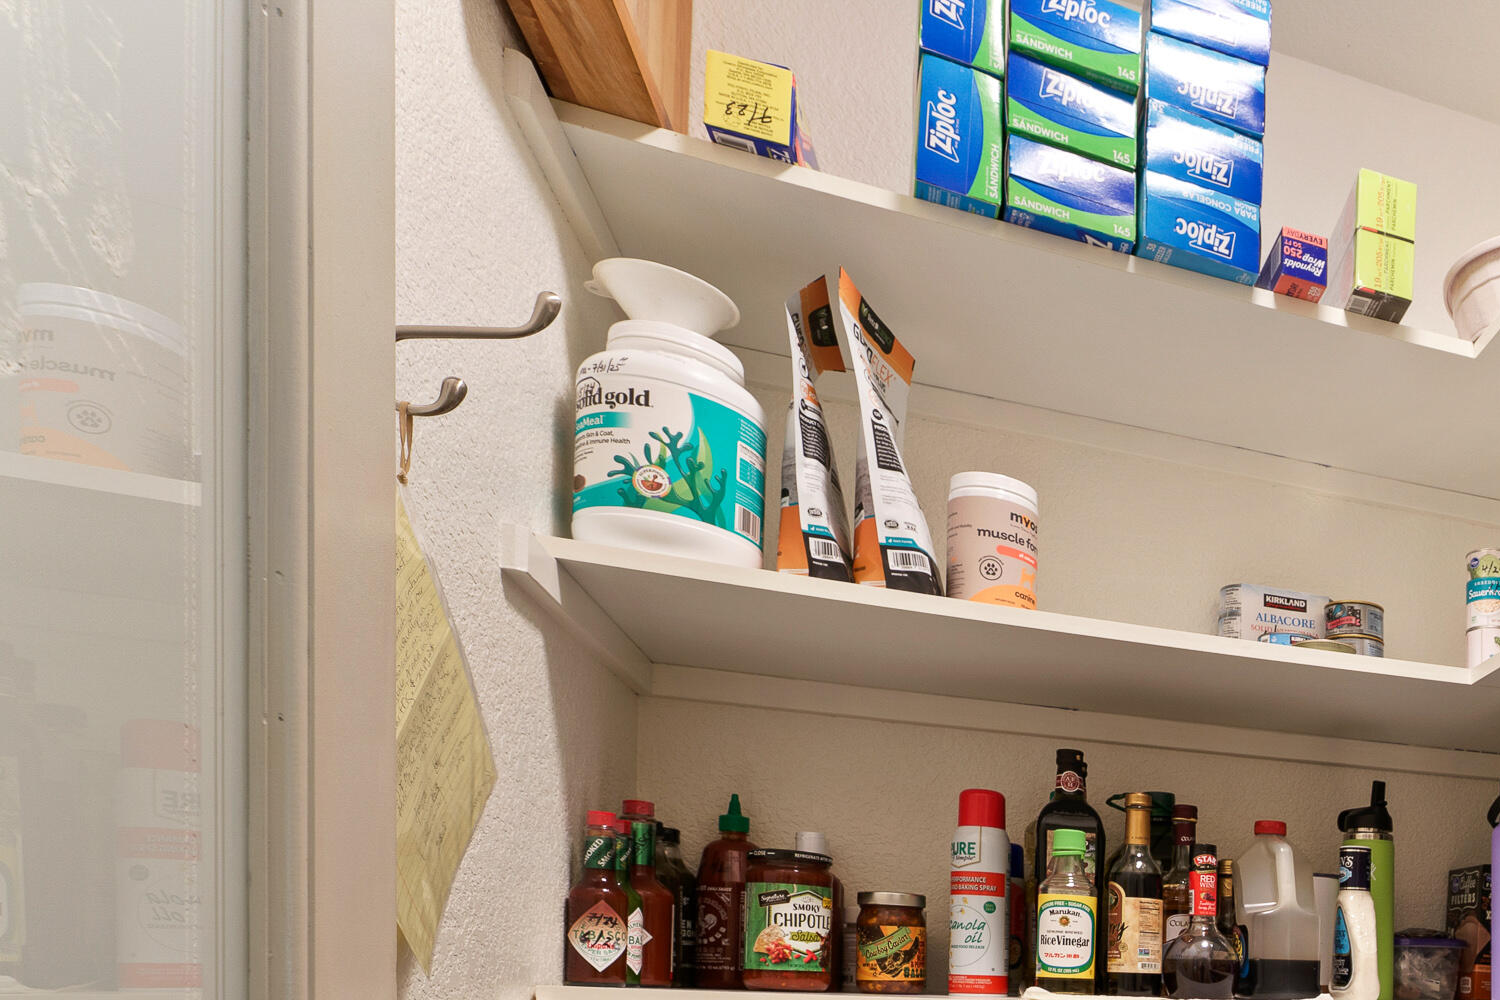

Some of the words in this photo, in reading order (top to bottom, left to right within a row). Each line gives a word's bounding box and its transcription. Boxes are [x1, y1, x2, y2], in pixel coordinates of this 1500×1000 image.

[1117, 66, 1136, 81] 145
[1177, 80, 1236, 119] Ziploc
[933, 90, 957, 155] Ziploc
[1113, 150, 1131, 164] 145
[1172, 152, 1231, 188] Ziploc
[1113, 224, 1131, 238] 145
[1175, 218, 1235, 259] Ziploc
[1287, 230, 1323, 246] EVERYDAY
[1284, 246, 1303, 260] 250
[1303, 253, 1325, 269] Wrap
[1284, 258, 1323, 277] Reynolds
[604, 387, 652, 409] gold
[977, 528, 1025, 546] muscle
[1265, 595, 1306, 609] KIRKLAND
[1256, 612, 1316, 629] ALBACORE
[1197, 856, 1217, 866] STAR
[1200, 874, 1216, 883] RED
[793, 903, 822, 913] SMOKY
[1049, 908, 1080, 917] Marukan
[774, 912, 831, 930] CHIPOTLE
[1040, 934, 1056, 946] Rice
[1057, 935, 1090, 948] Vinegar
